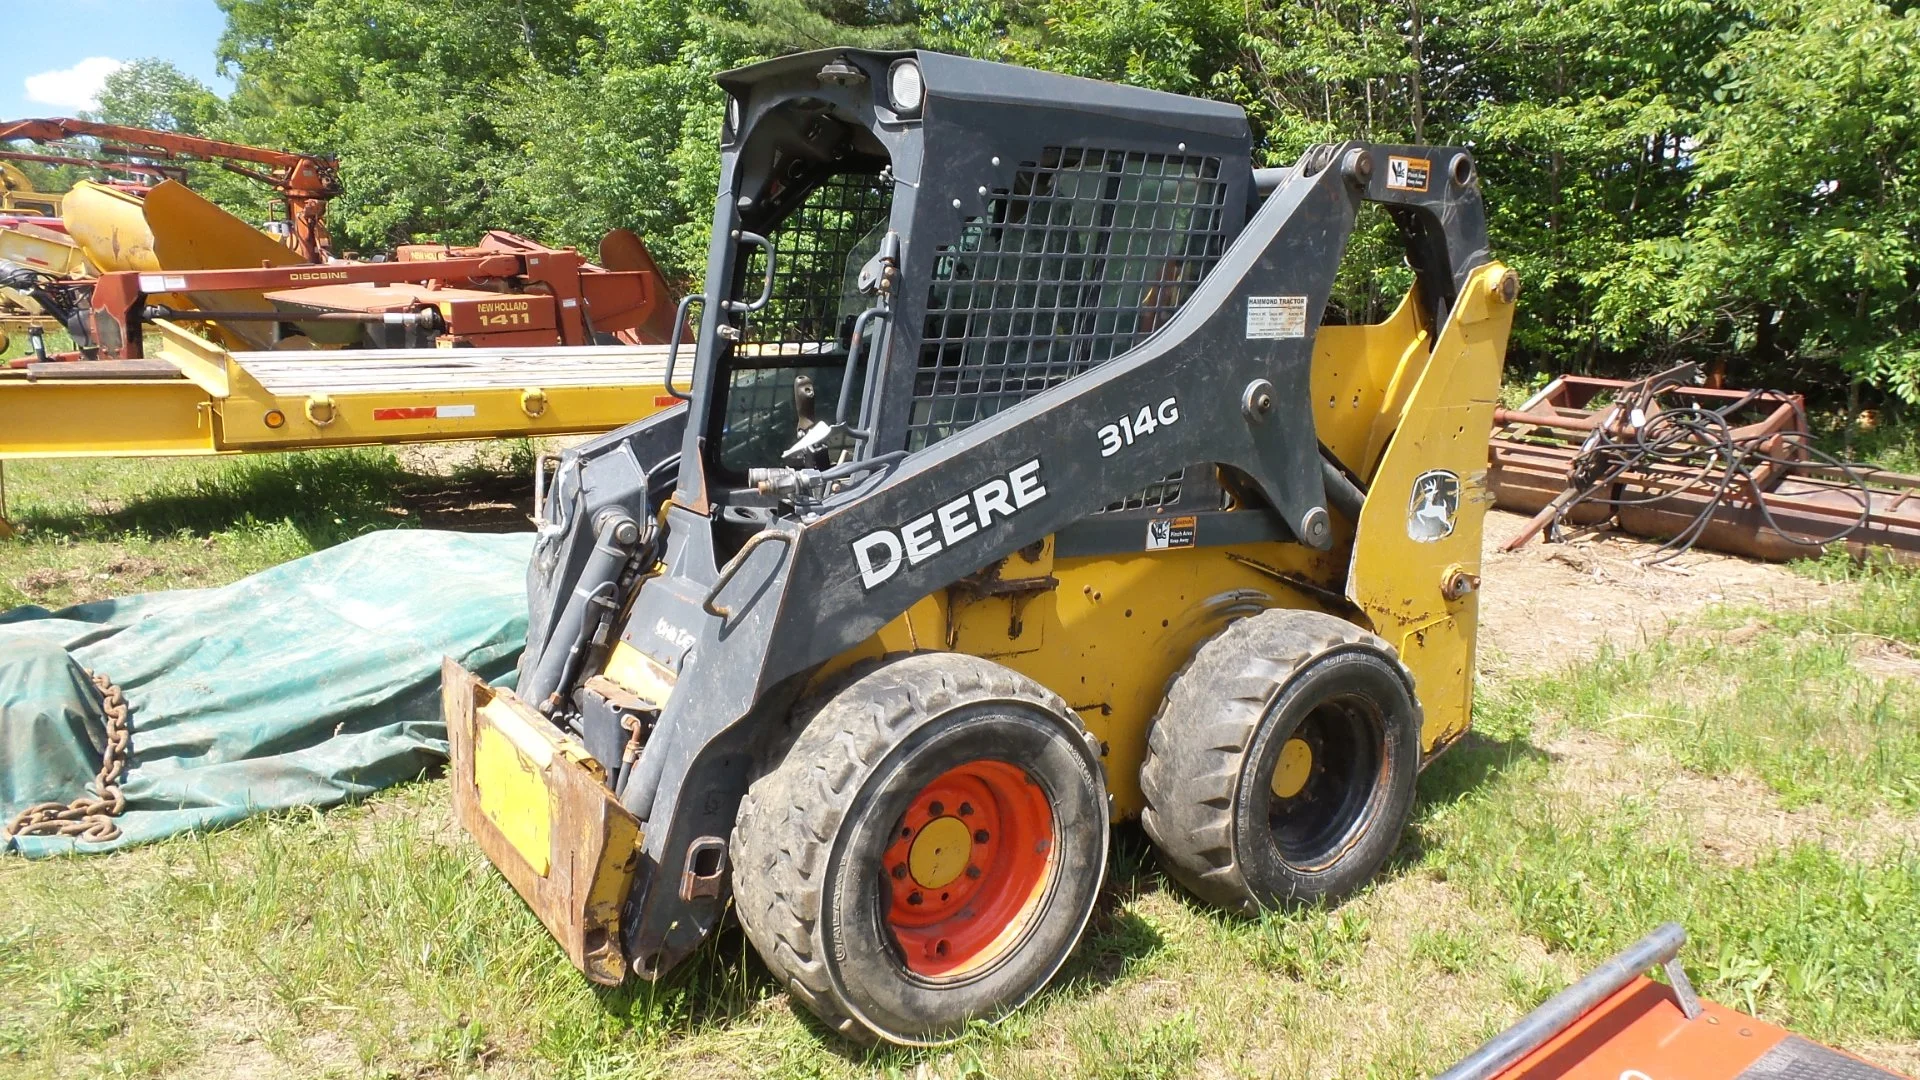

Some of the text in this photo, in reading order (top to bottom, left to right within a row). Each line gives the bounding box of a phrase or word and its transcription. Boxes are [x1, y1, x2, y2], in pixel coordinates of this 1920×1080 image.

[477, 301, 528, 312] NEW HOLLAND
[479, 312, 530, 326] 1411
[1097, 396, 1180, 458] 314G
[851, 458, 1047, 590] DEERE
